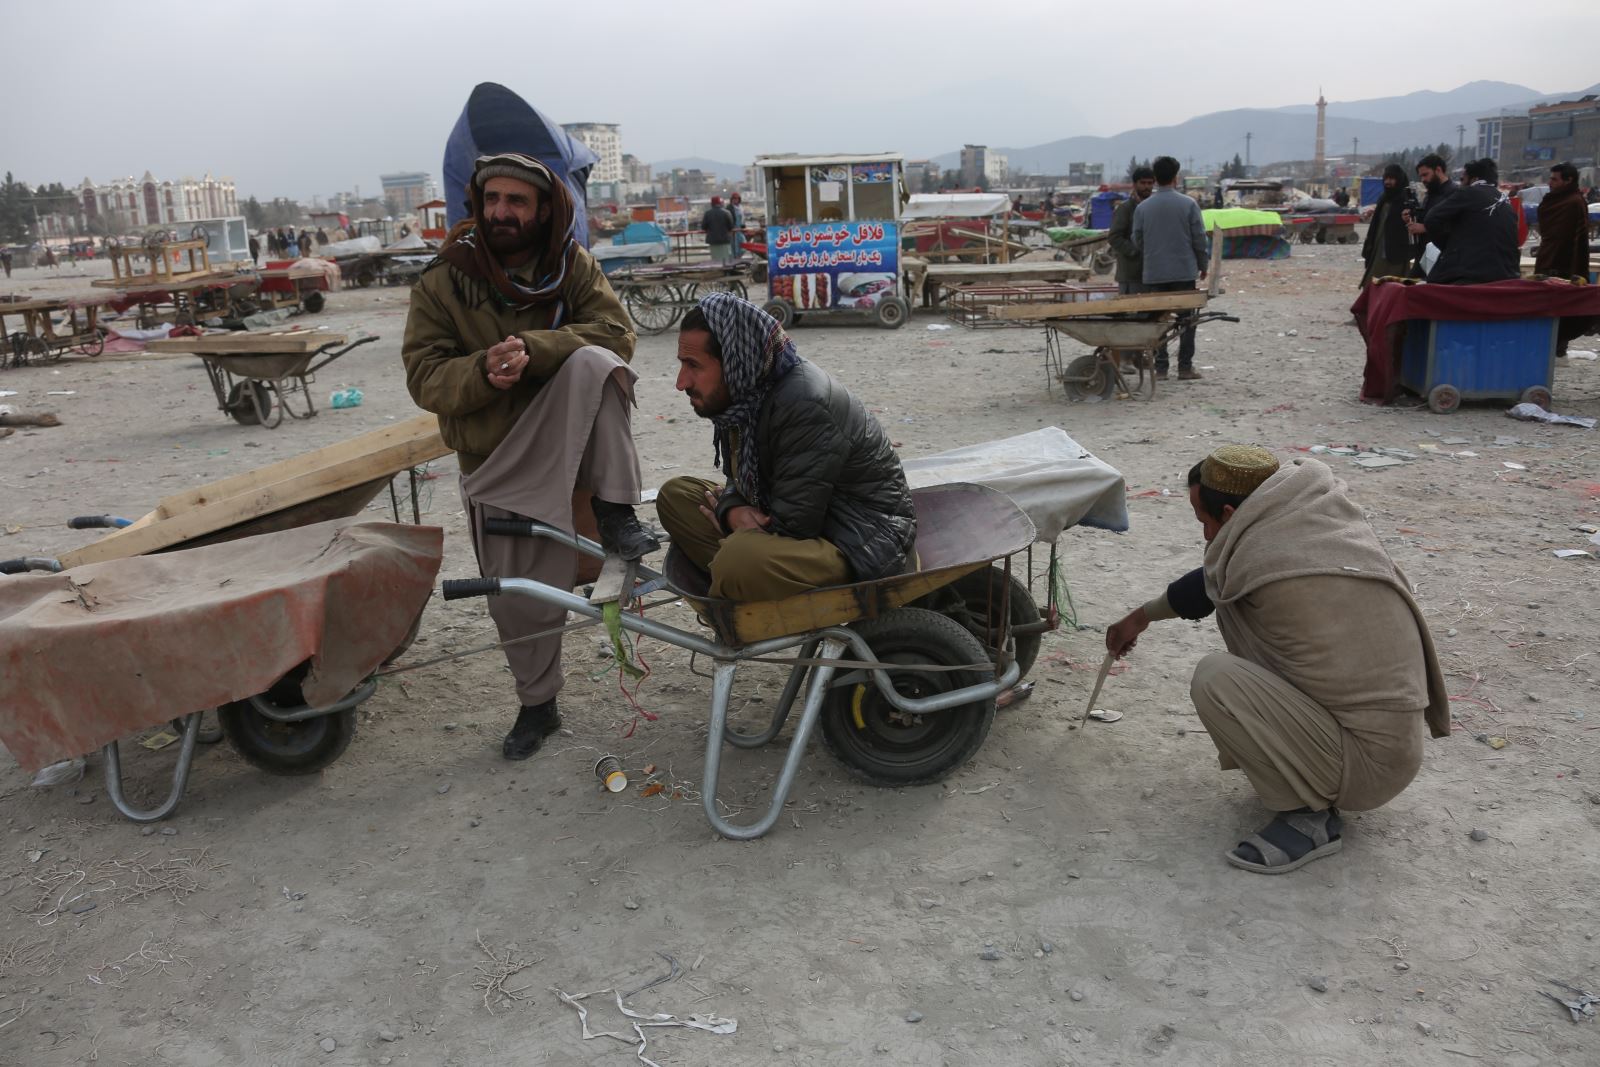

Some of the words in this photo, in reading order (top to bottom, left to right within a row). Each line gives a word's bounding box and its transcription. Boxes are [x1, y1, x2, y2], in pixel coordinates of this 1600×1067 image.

[804, 224, 850, 247] خوشمزه
[853, 224, 884, 245] فلافل
[830, 250, 856, 266] امتحان
